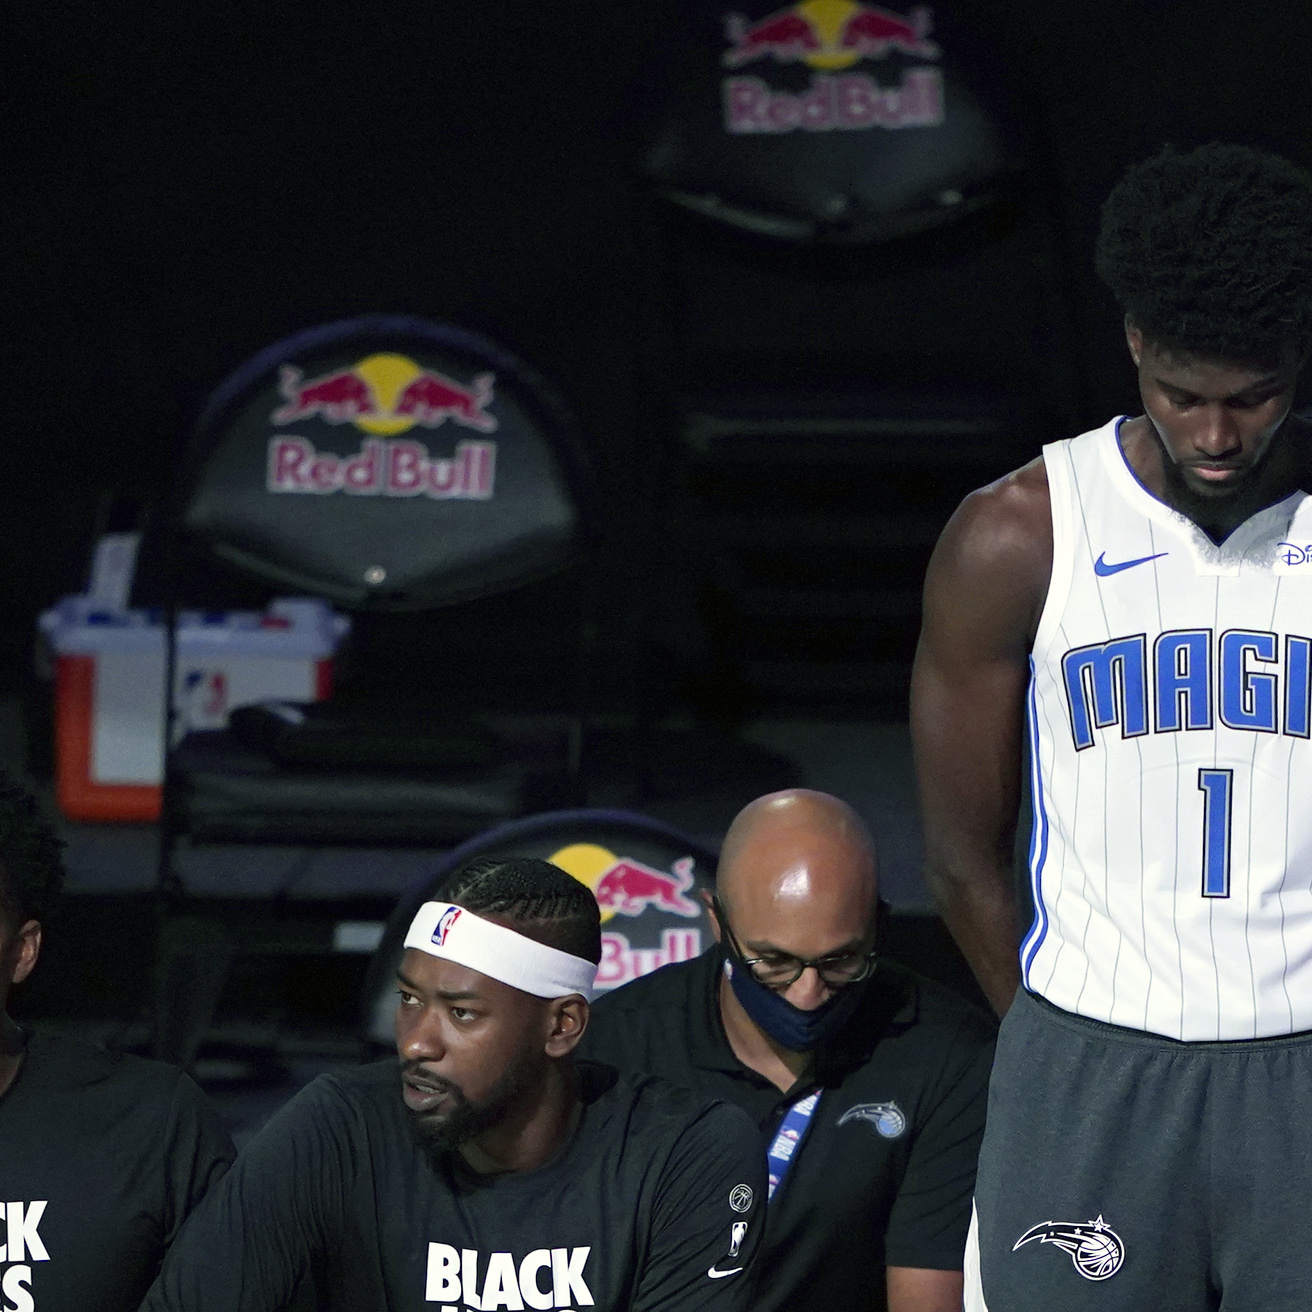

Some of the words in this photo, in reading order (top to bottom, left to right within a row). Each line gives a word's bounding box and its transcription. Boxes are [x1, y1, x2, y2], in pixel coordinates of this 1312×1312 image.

[722, 74, 836, 134] Red
[837, 66, 944, 130] Bull
[266, 435, 386, 496] Red
[386, 438, 496, 500] Bull
[1198, 768, 1234, 899] 1
[425, 1242, 595, 1311] BLACK
